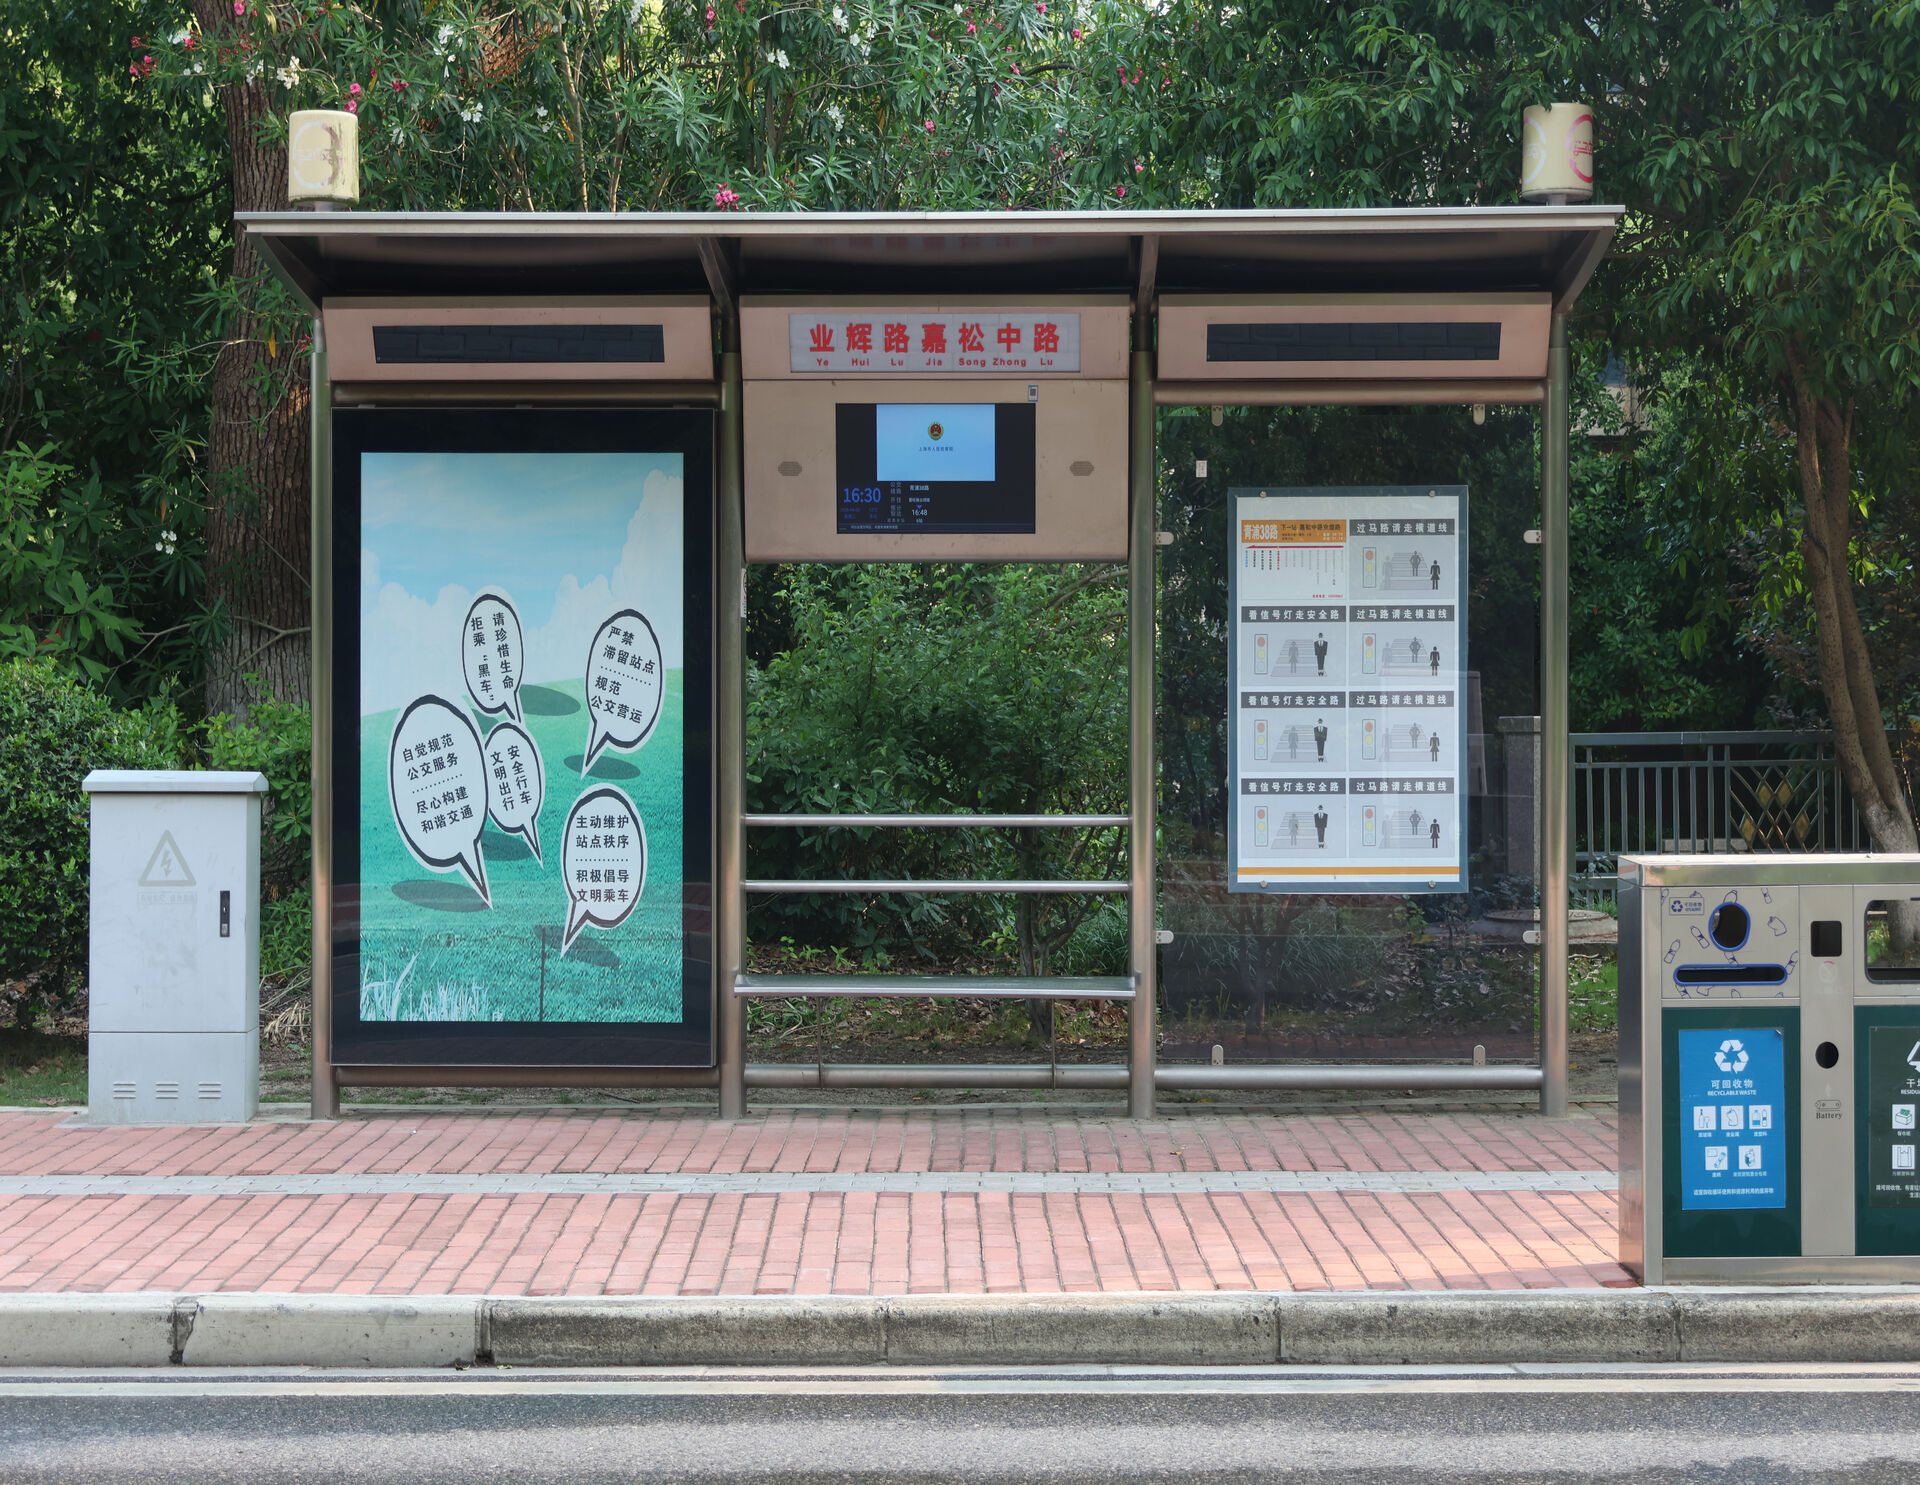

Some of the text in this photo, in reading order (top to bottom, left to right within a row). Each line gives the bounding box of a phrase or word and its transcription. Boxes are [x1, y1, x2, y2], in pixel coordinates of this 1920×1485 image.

[809, 322, 1060, 354] 业辉路嘉松中路
[816, 357, 1054, 368] Ye Hui Lu Jia Song Zhong Lu
[843, 487, 882, 503] 16:30
[911, 508, 928, 516] 16:48
[1243, 523, 1279, 541] 青浦38路
[1356, 522, 1448, 534] 过马路请走横道线
[1248, 609, 1340, 621] 看信号灯走安全路
[1356, 608, 1447, 620] 过马路请走横道线
[608, 625, 635, 646] 严禁
[492, 611, 514, 689] 请珍惜生命
[602, 644, 656, 675] 滞留站点
[594, 675, 622, 696] 规范
[1248, 695, 1339, 707] 看信号灯走安全路
[1356, 694, 1447, 706] 过马路请走横道线
[590, 695, 643, 724] 公交营运
[402, 733, 455, 763] 自觉规范
[407, 752, 459, 781] 公交服务
[490, 751, 515, 812] 文明出行
[507, 744, 532, 805] 安全行车
[1248, 781, 1340, 793] 看信号灯走安全路
[1356, 780, 1447, 792] 过马路请走横道线
[416, 786, 469, 815] 尽心构建
[421, 804, 474, 834] 和谐交通
[575, 814, 630, 829] 主动维护
[575, 834, 630, 849] 站点秩序
[575, 868, 630, 883] 积极倡导
[575, 888, 630, 903] 文明乘车
[1710, 1078, 1753, 1090] 可回收物
[1707, 1089, 1739, 1097] RECYCLABLE
[1815, 1112, 1843, 1120] Battery
